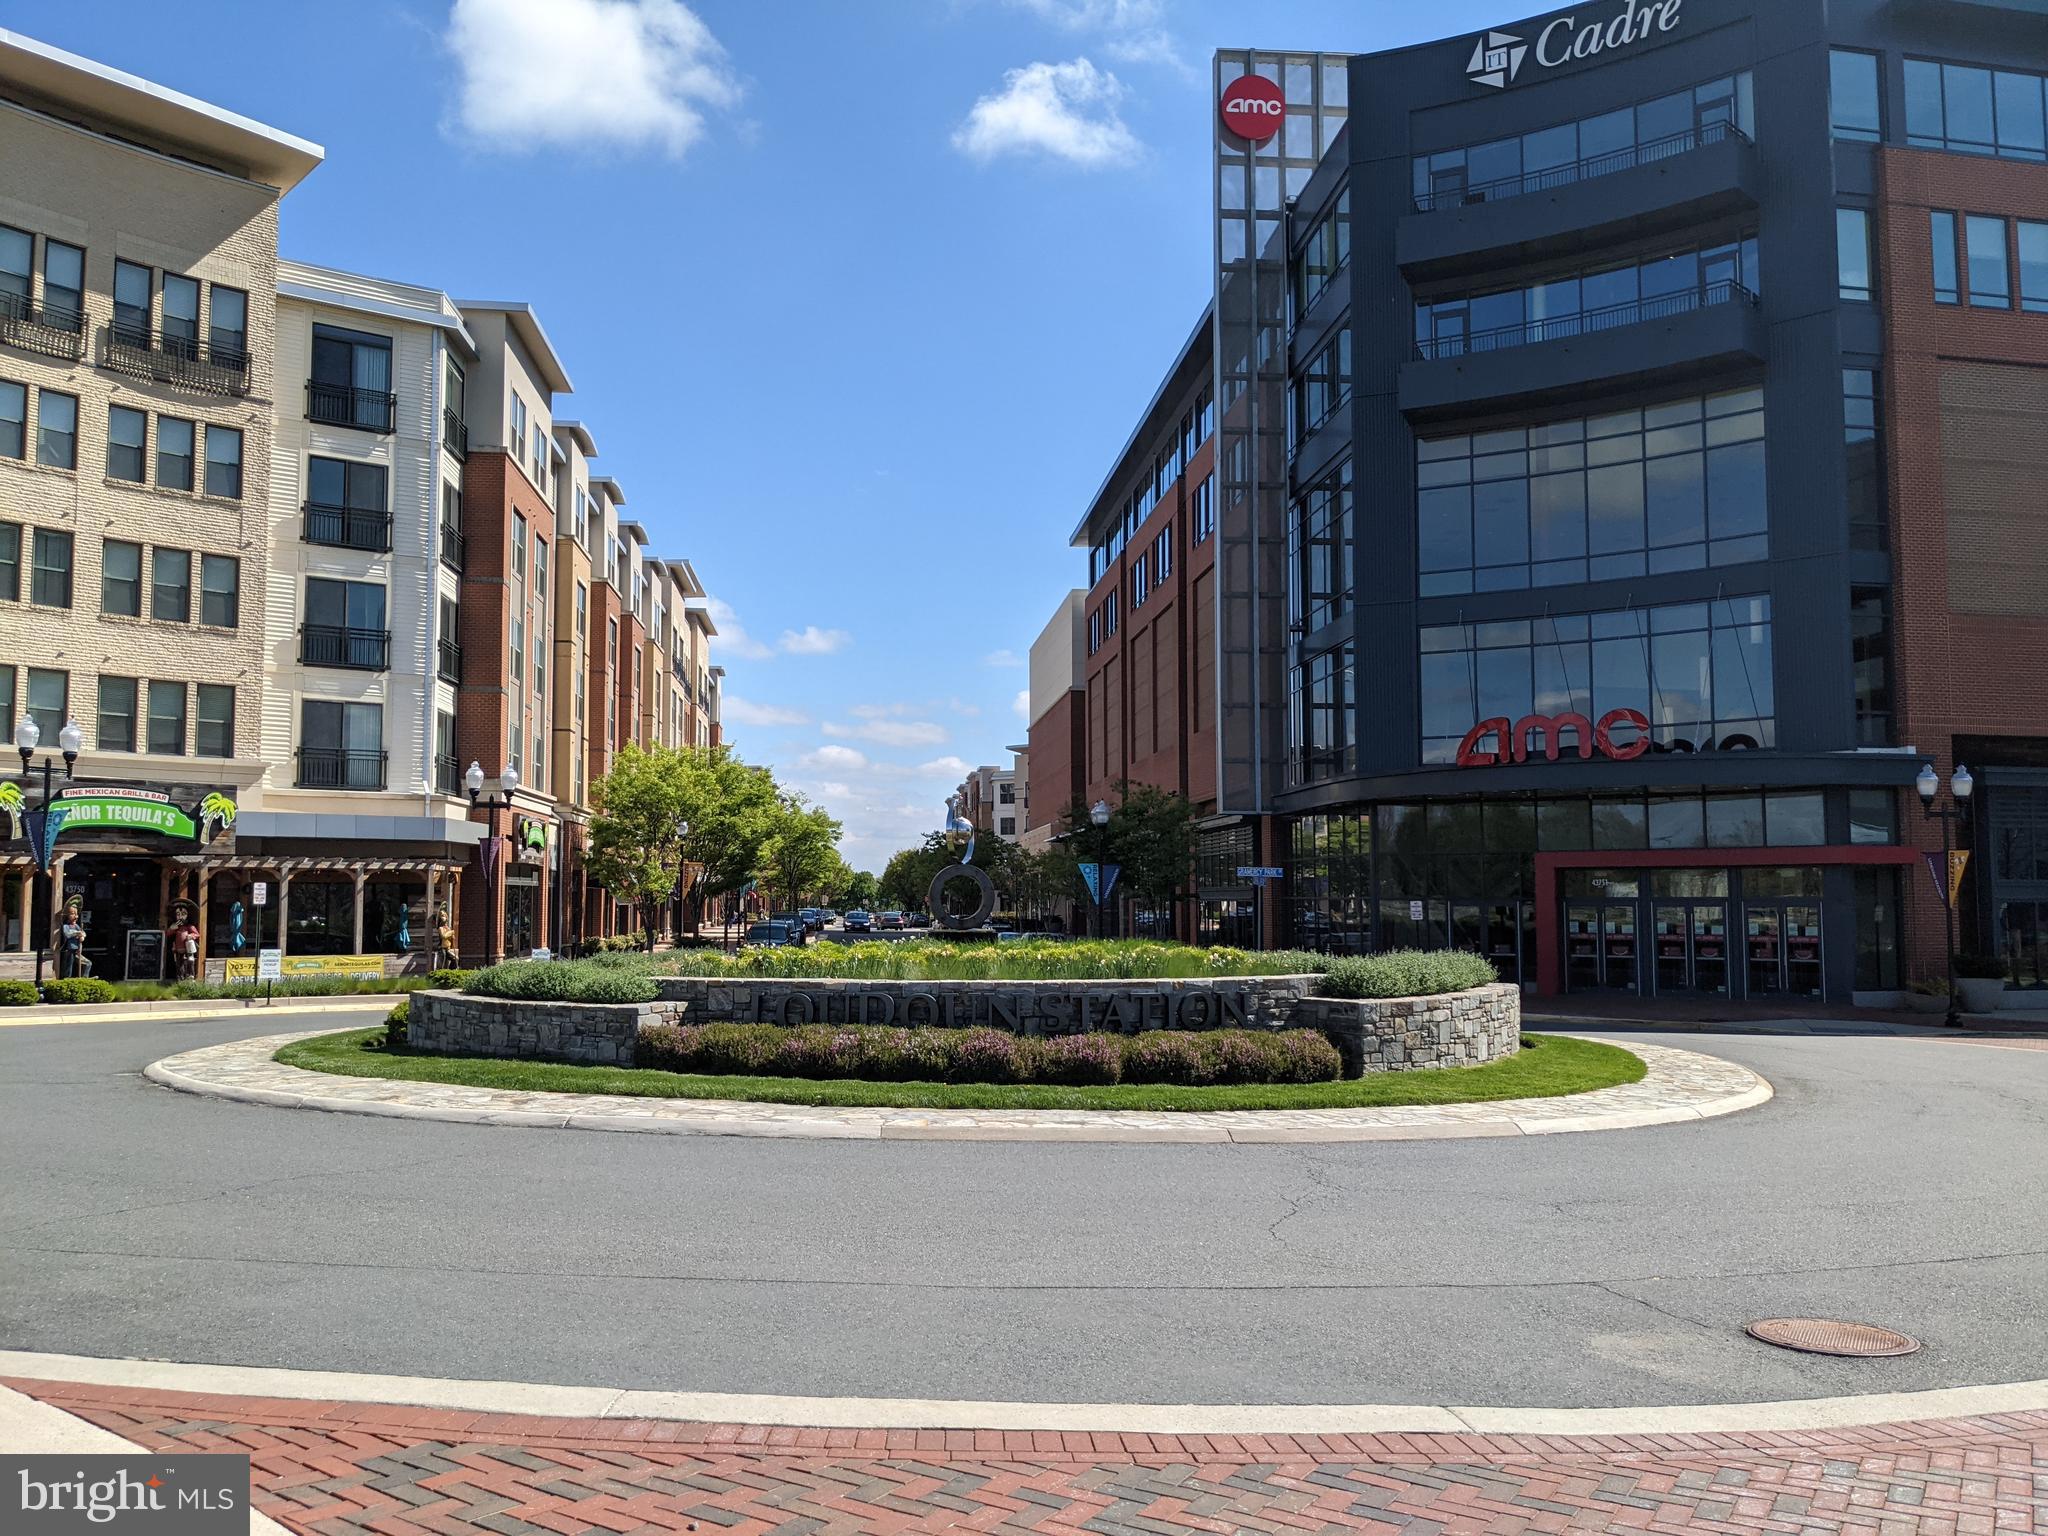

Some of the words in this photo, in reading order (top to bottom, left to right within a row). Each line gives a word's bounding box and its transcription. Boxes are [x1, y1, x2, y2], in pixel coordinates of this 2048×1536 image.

[1536, 0, 1681, 67] Cadre
[1487, 51, 1506, 68] IT
[121, 790, 143, 798] GRILL
[56, 804, 101, 821] EÑOR
[106, 805, 176, 827] TEQUILA'S
[1039, 991, 1254, 1032] STATION
